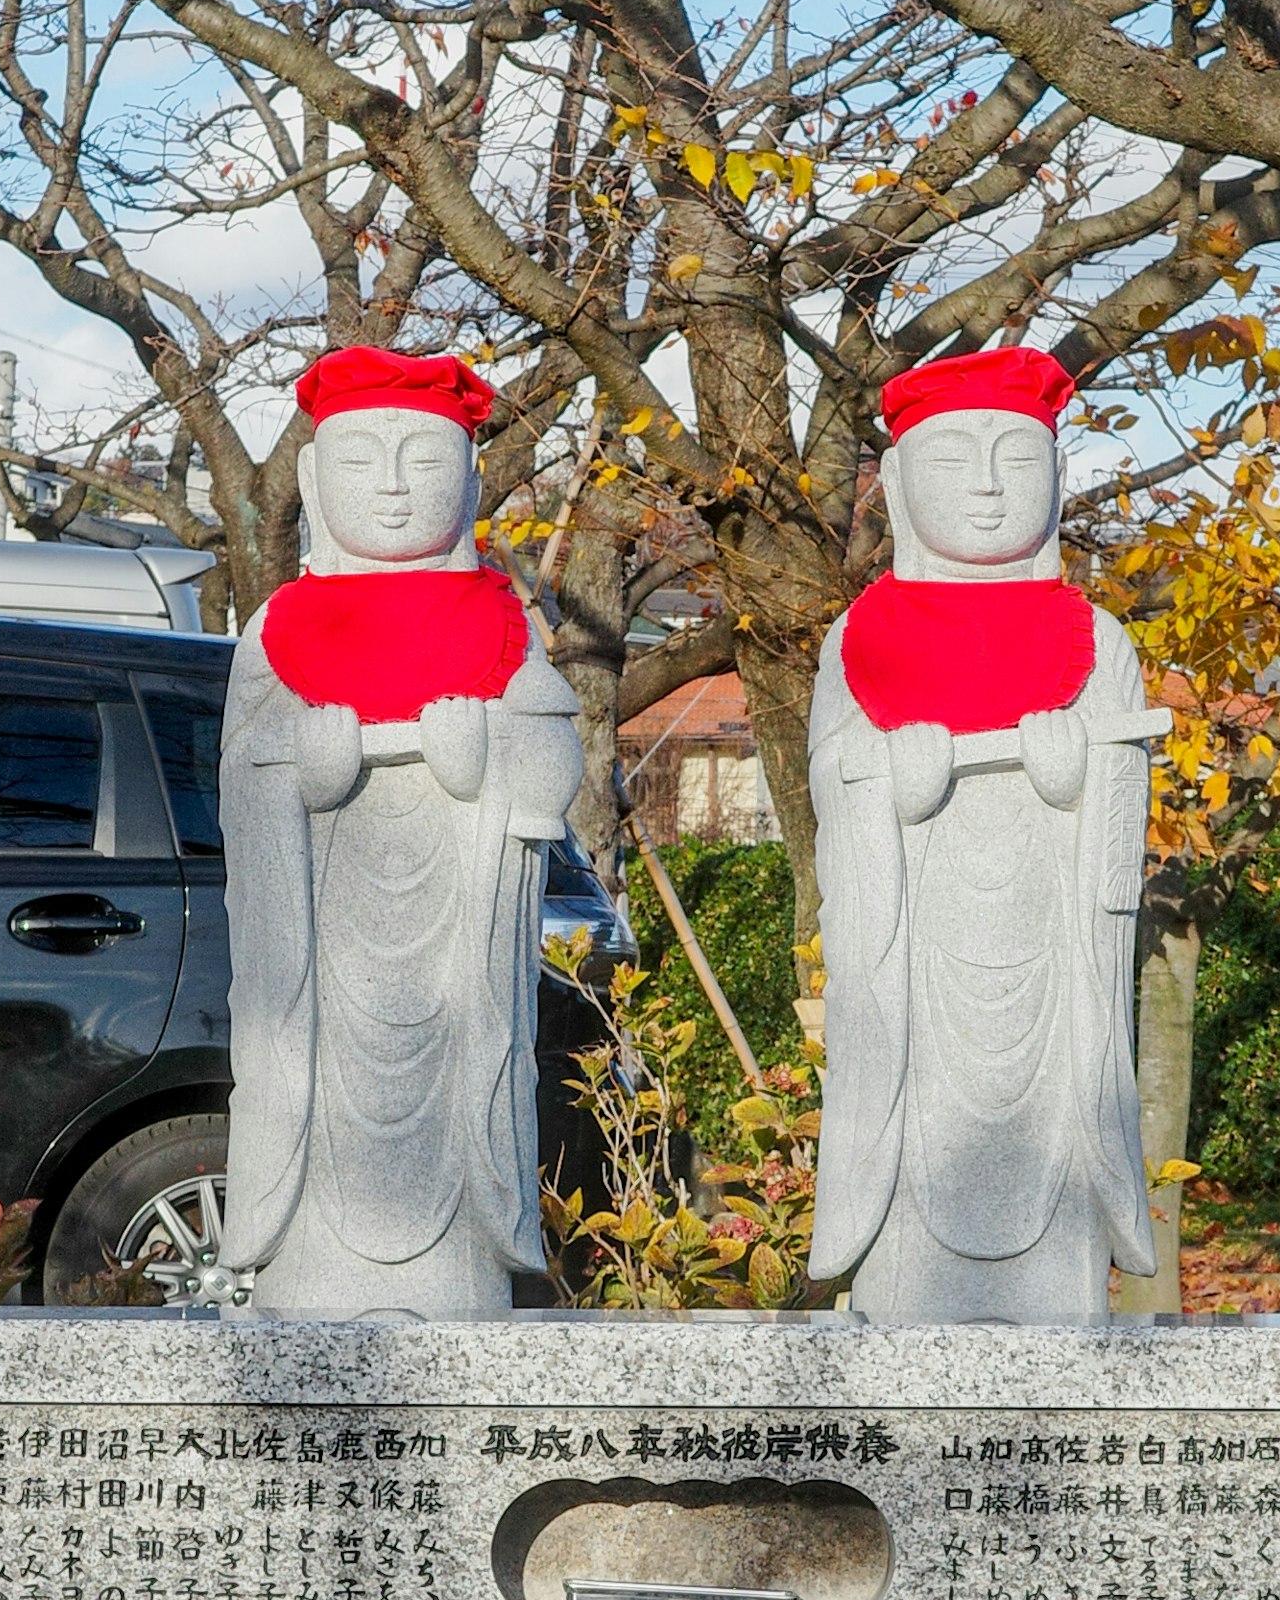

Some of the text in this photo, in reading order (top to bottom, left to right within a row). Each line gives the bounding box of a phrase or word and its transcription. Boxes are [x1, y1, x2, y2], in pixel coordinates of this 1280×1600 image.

[480, 1420, 900, 1465] 平成八年秋彼岸供養
